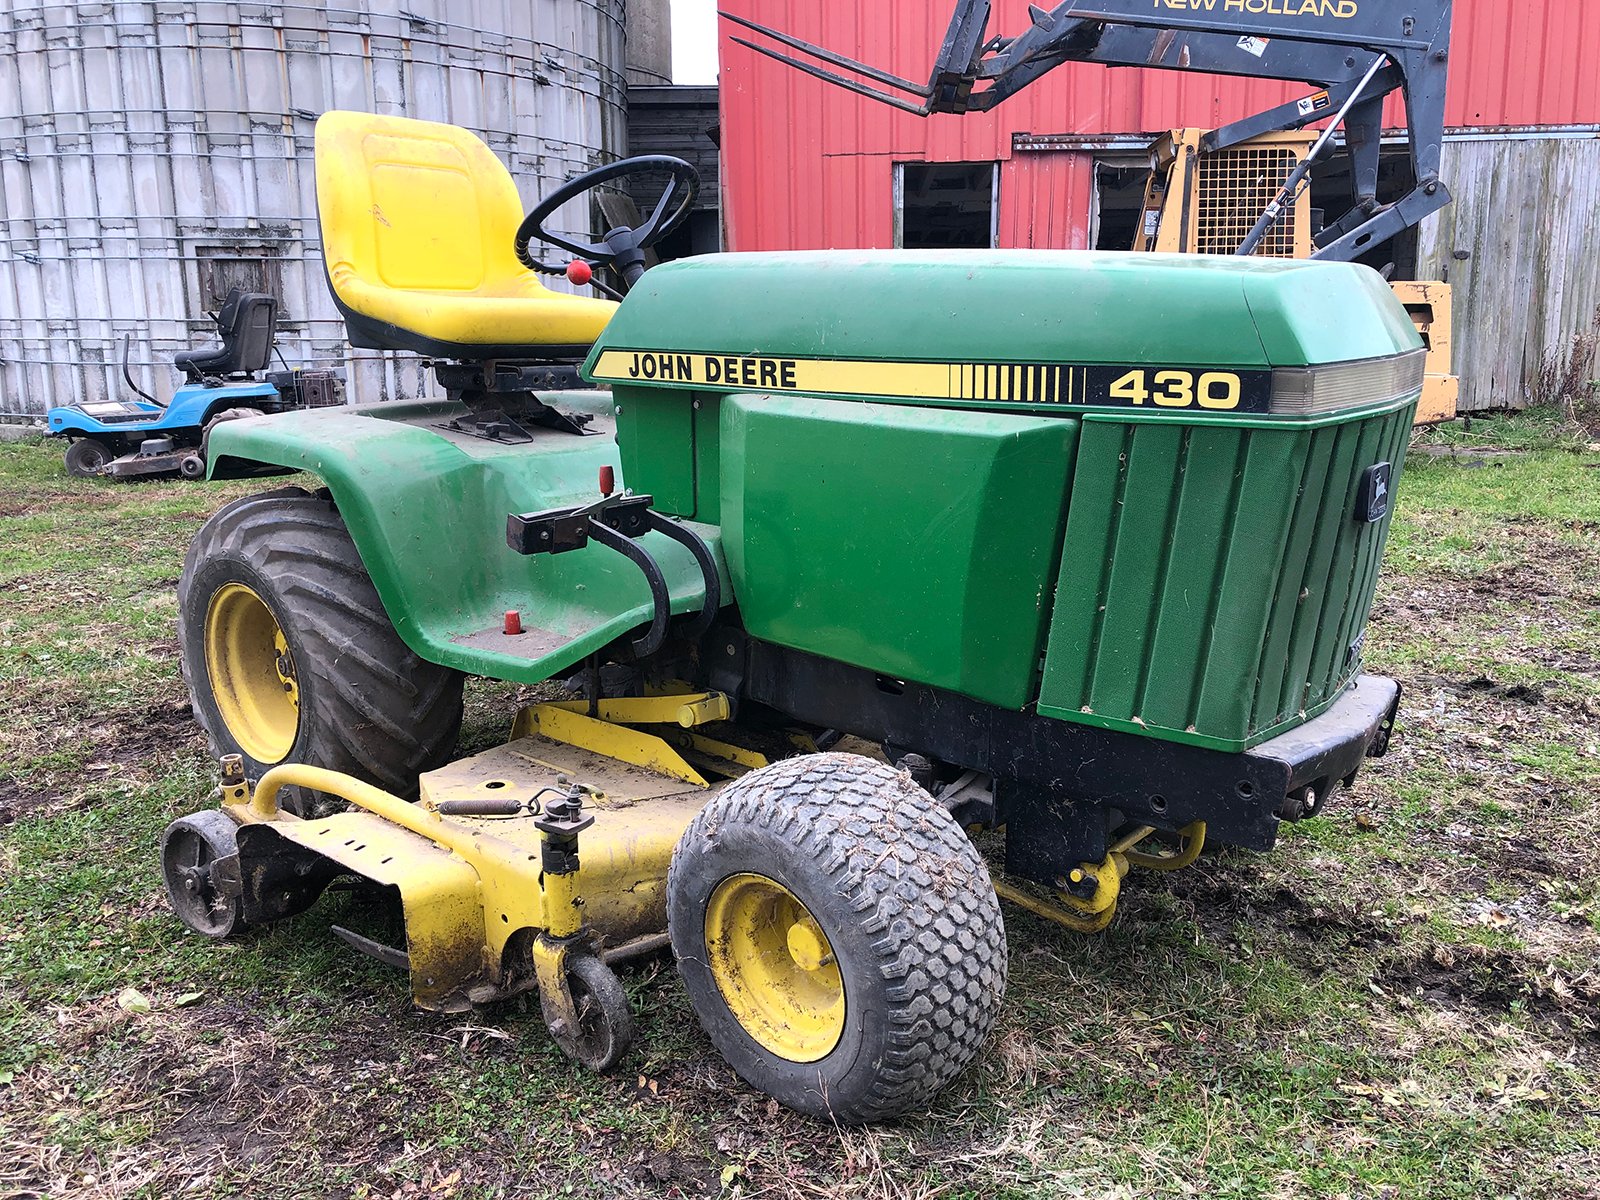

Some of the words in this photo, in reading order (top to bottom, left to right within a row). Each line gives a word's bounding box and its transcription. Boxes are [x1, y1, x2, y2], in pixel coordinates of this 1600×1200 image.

[1224, 0, 1358, 18] HOLLAND
[629, 354, 692, 380] JOHN
[705, 357, 796, 388] DEERE
[1109, 370, 1241, 409] 430
